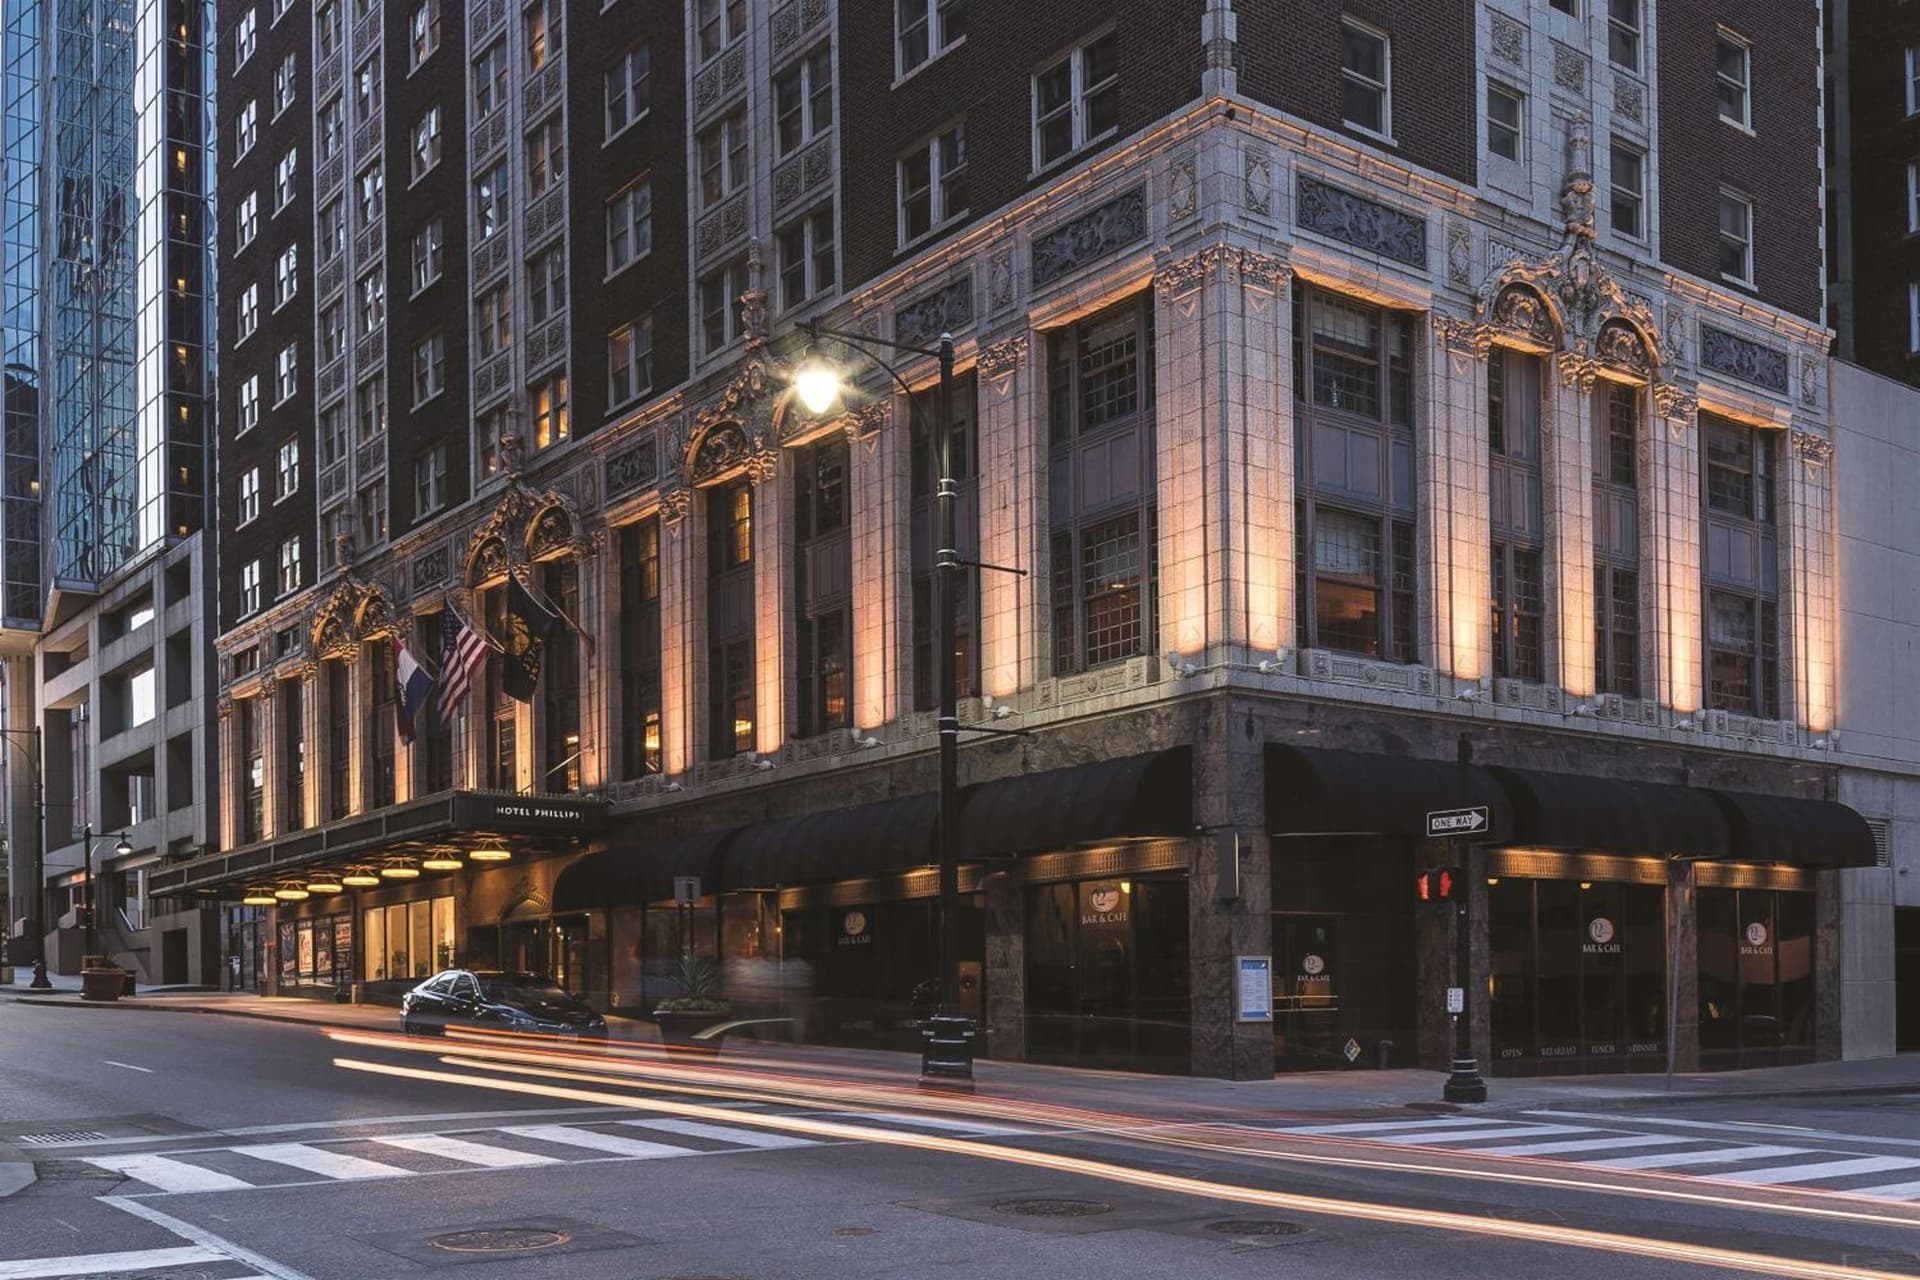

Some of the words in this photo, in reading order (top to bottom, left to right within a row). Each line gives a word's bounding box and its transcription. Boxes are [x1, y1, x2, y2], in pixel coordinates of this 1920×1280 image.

[496, 807, 530, 817] HOTEL
[534, 809, 580, 819] PHILLIPS
[1434, 818, 1451, 828] ONE
[1455, 815, 1473, 826] WAY
[1082, 914, 1097, 925] BAR
[1099, 913, 1106, 923] &
[1582, 944, 1596, 953] BAR
[1597, 944, 1603, 953] &
[1502, 1048, 1523, 1057] OPEN
[1591, 1045, 1615, 1054] LUNCH
